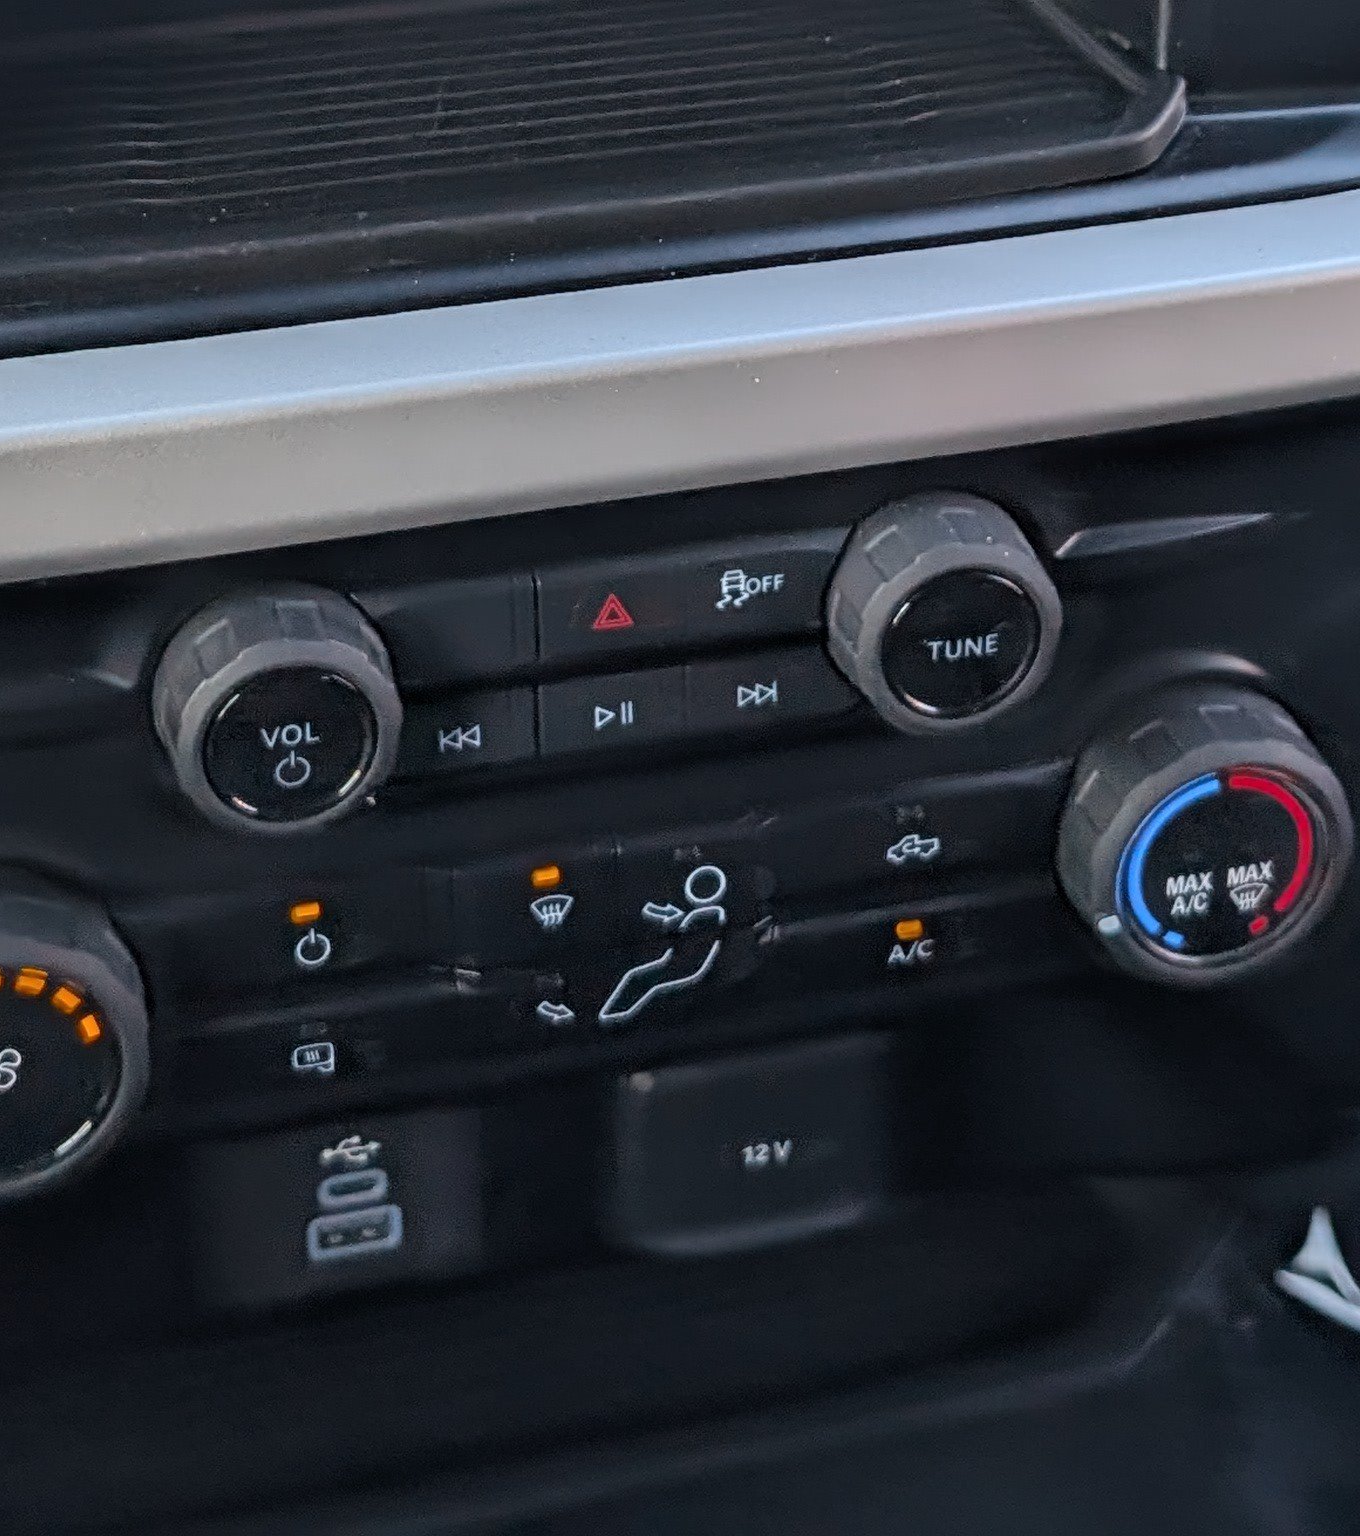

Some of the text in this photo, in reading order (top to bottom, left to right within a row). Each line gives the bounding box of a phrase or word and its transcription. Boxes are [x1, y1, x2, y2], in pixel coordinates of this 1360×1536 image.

[747, 573, 785, 595] OFF
[927, 631, 1000, 661] TUNE
[260, 722, 320, 749] VOL
[1165, 871, 1214, 897] MAX
[1226, 860, 1274, 887] MAX
[1170, 892, 1209, 916] A/C
[887, 938, 935, 966] A/C
